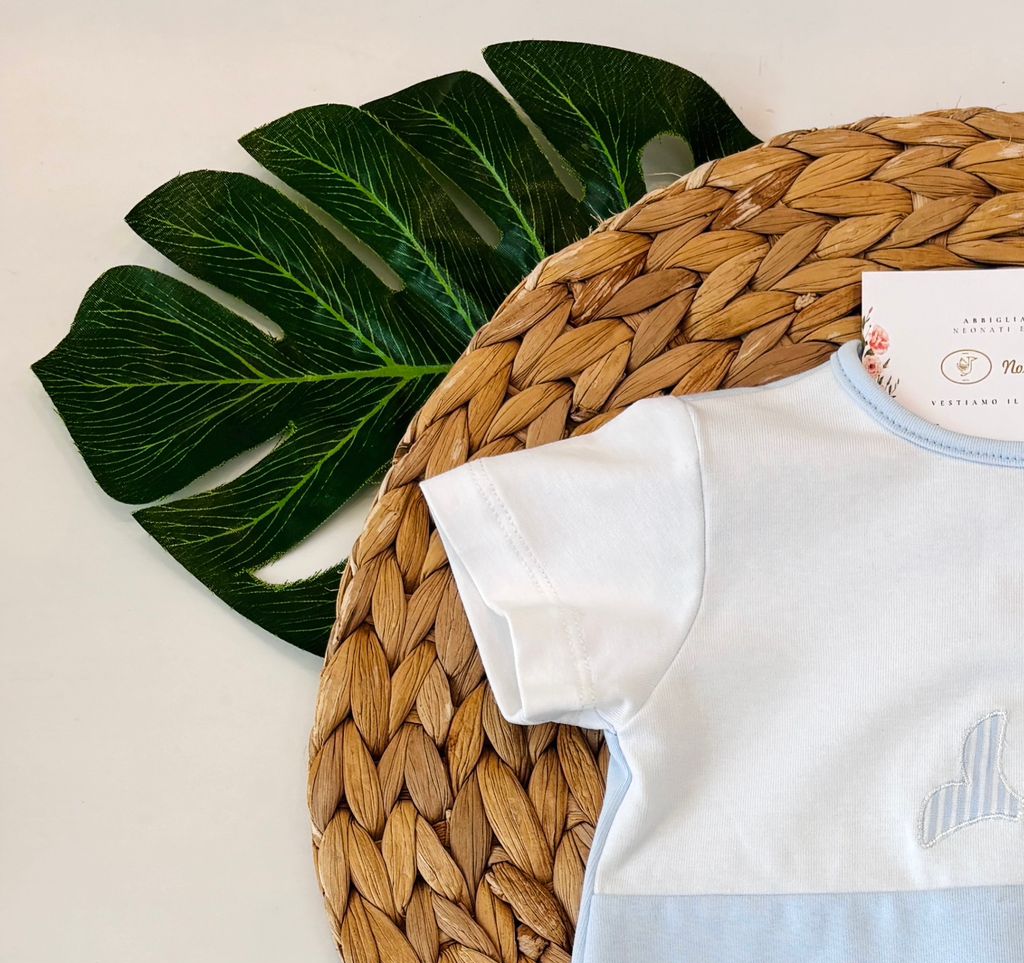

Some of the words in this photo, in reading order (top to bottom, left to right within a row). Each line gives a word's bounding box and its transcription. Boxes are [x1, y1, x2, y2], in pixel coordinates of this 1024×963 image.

[953, 325, 1011, 335] NEONATI
[1019, 325, 1024, 333] E
[931, 398, 998, 407] VESTIAMO
